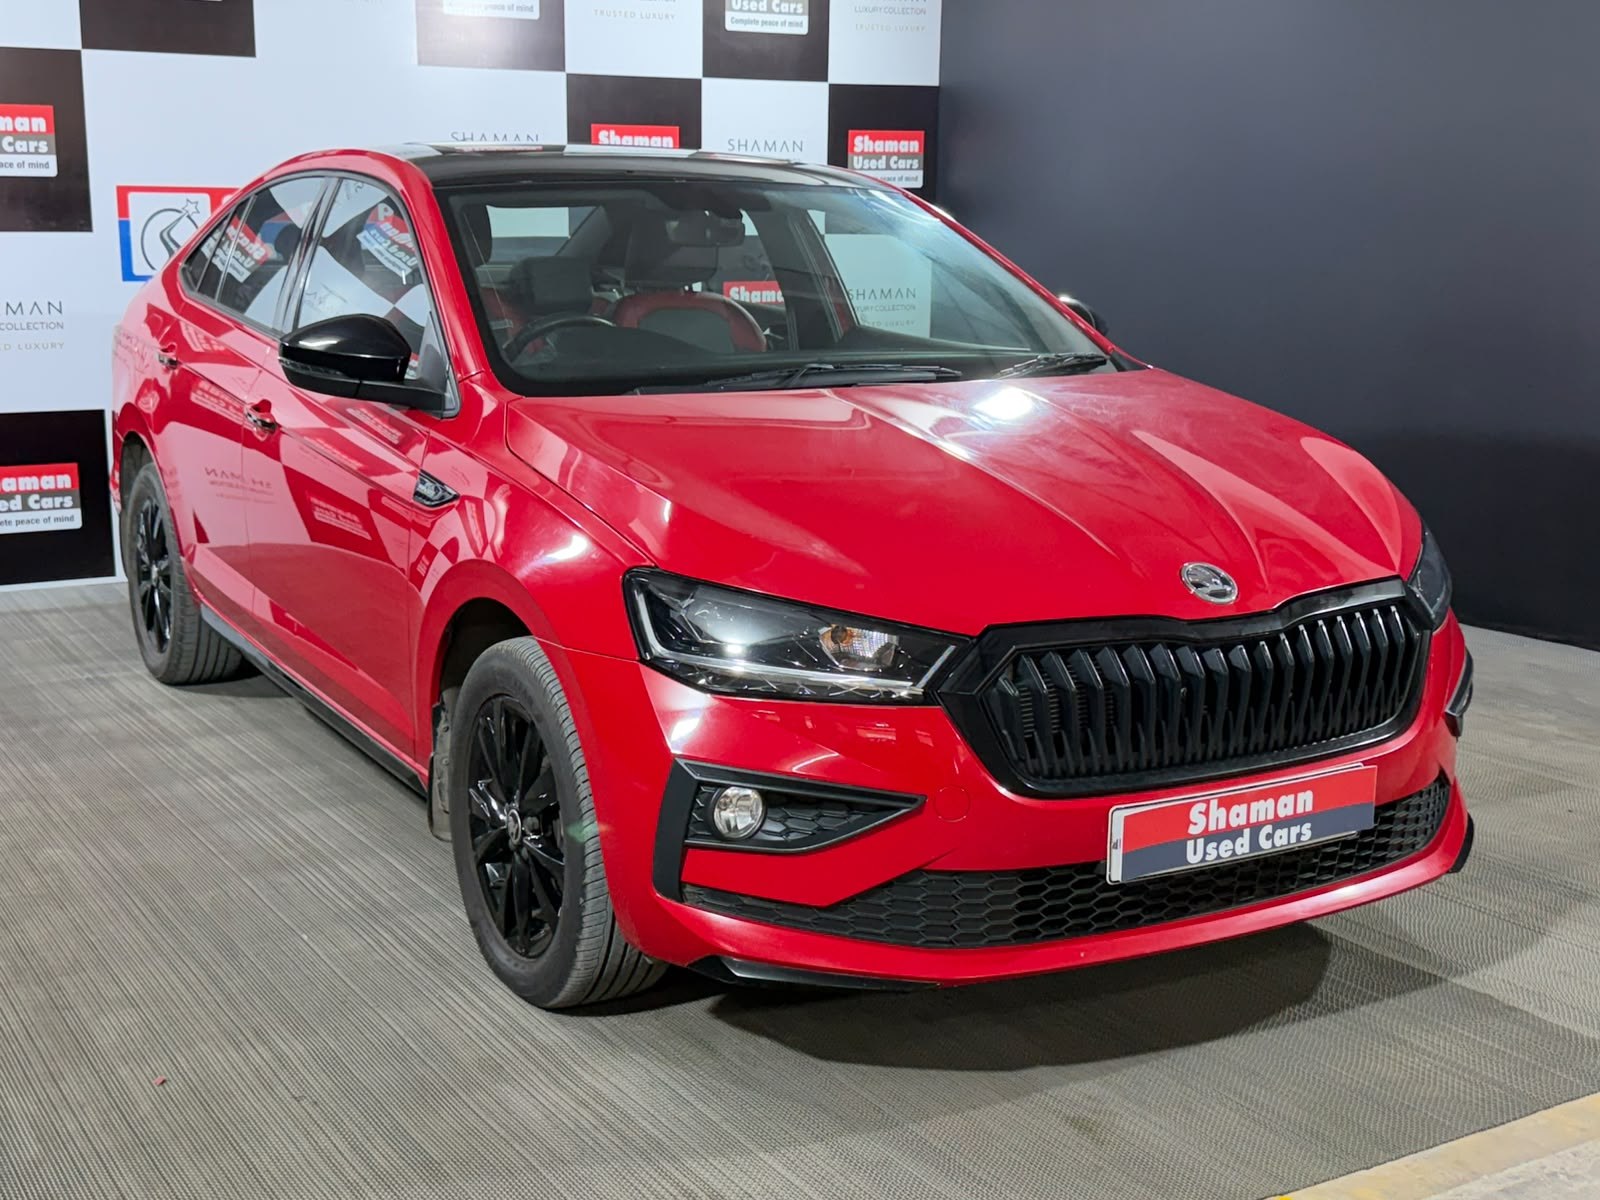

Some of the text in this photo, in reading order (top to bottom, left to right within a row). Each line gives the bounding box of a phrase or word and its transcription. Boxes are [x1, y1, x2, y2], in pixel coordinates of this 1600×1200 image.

[731, 0, 804, 13] Used Cars
[884, 7, 927, 15] COLLECTION
[731, 16, 759, 26] Complete
[761, 19, 779, 28] peace
[2, 136, 49, 153] Cars
[598, 129, 675, 148] Shaman
[728, 138, 803, 152] SHAMAN
[854, 135, 920, 153] Shaman
[17, 160, 26, 168] of
[28, 161, 49, 169] mind
[853, 155, 919, 169] Used Cars
[730, 286, 785, 303] Shama
[0, 321, 64, 331] COLLECTION
[18, 342, 64, 350] LUXURY
[28, 494, 73, 510] Cars
[15, 517, 40, 527] peace
[1187, 789, 1314, 835] Shaman
[1186, 822, 1312, 864] Used Cars
